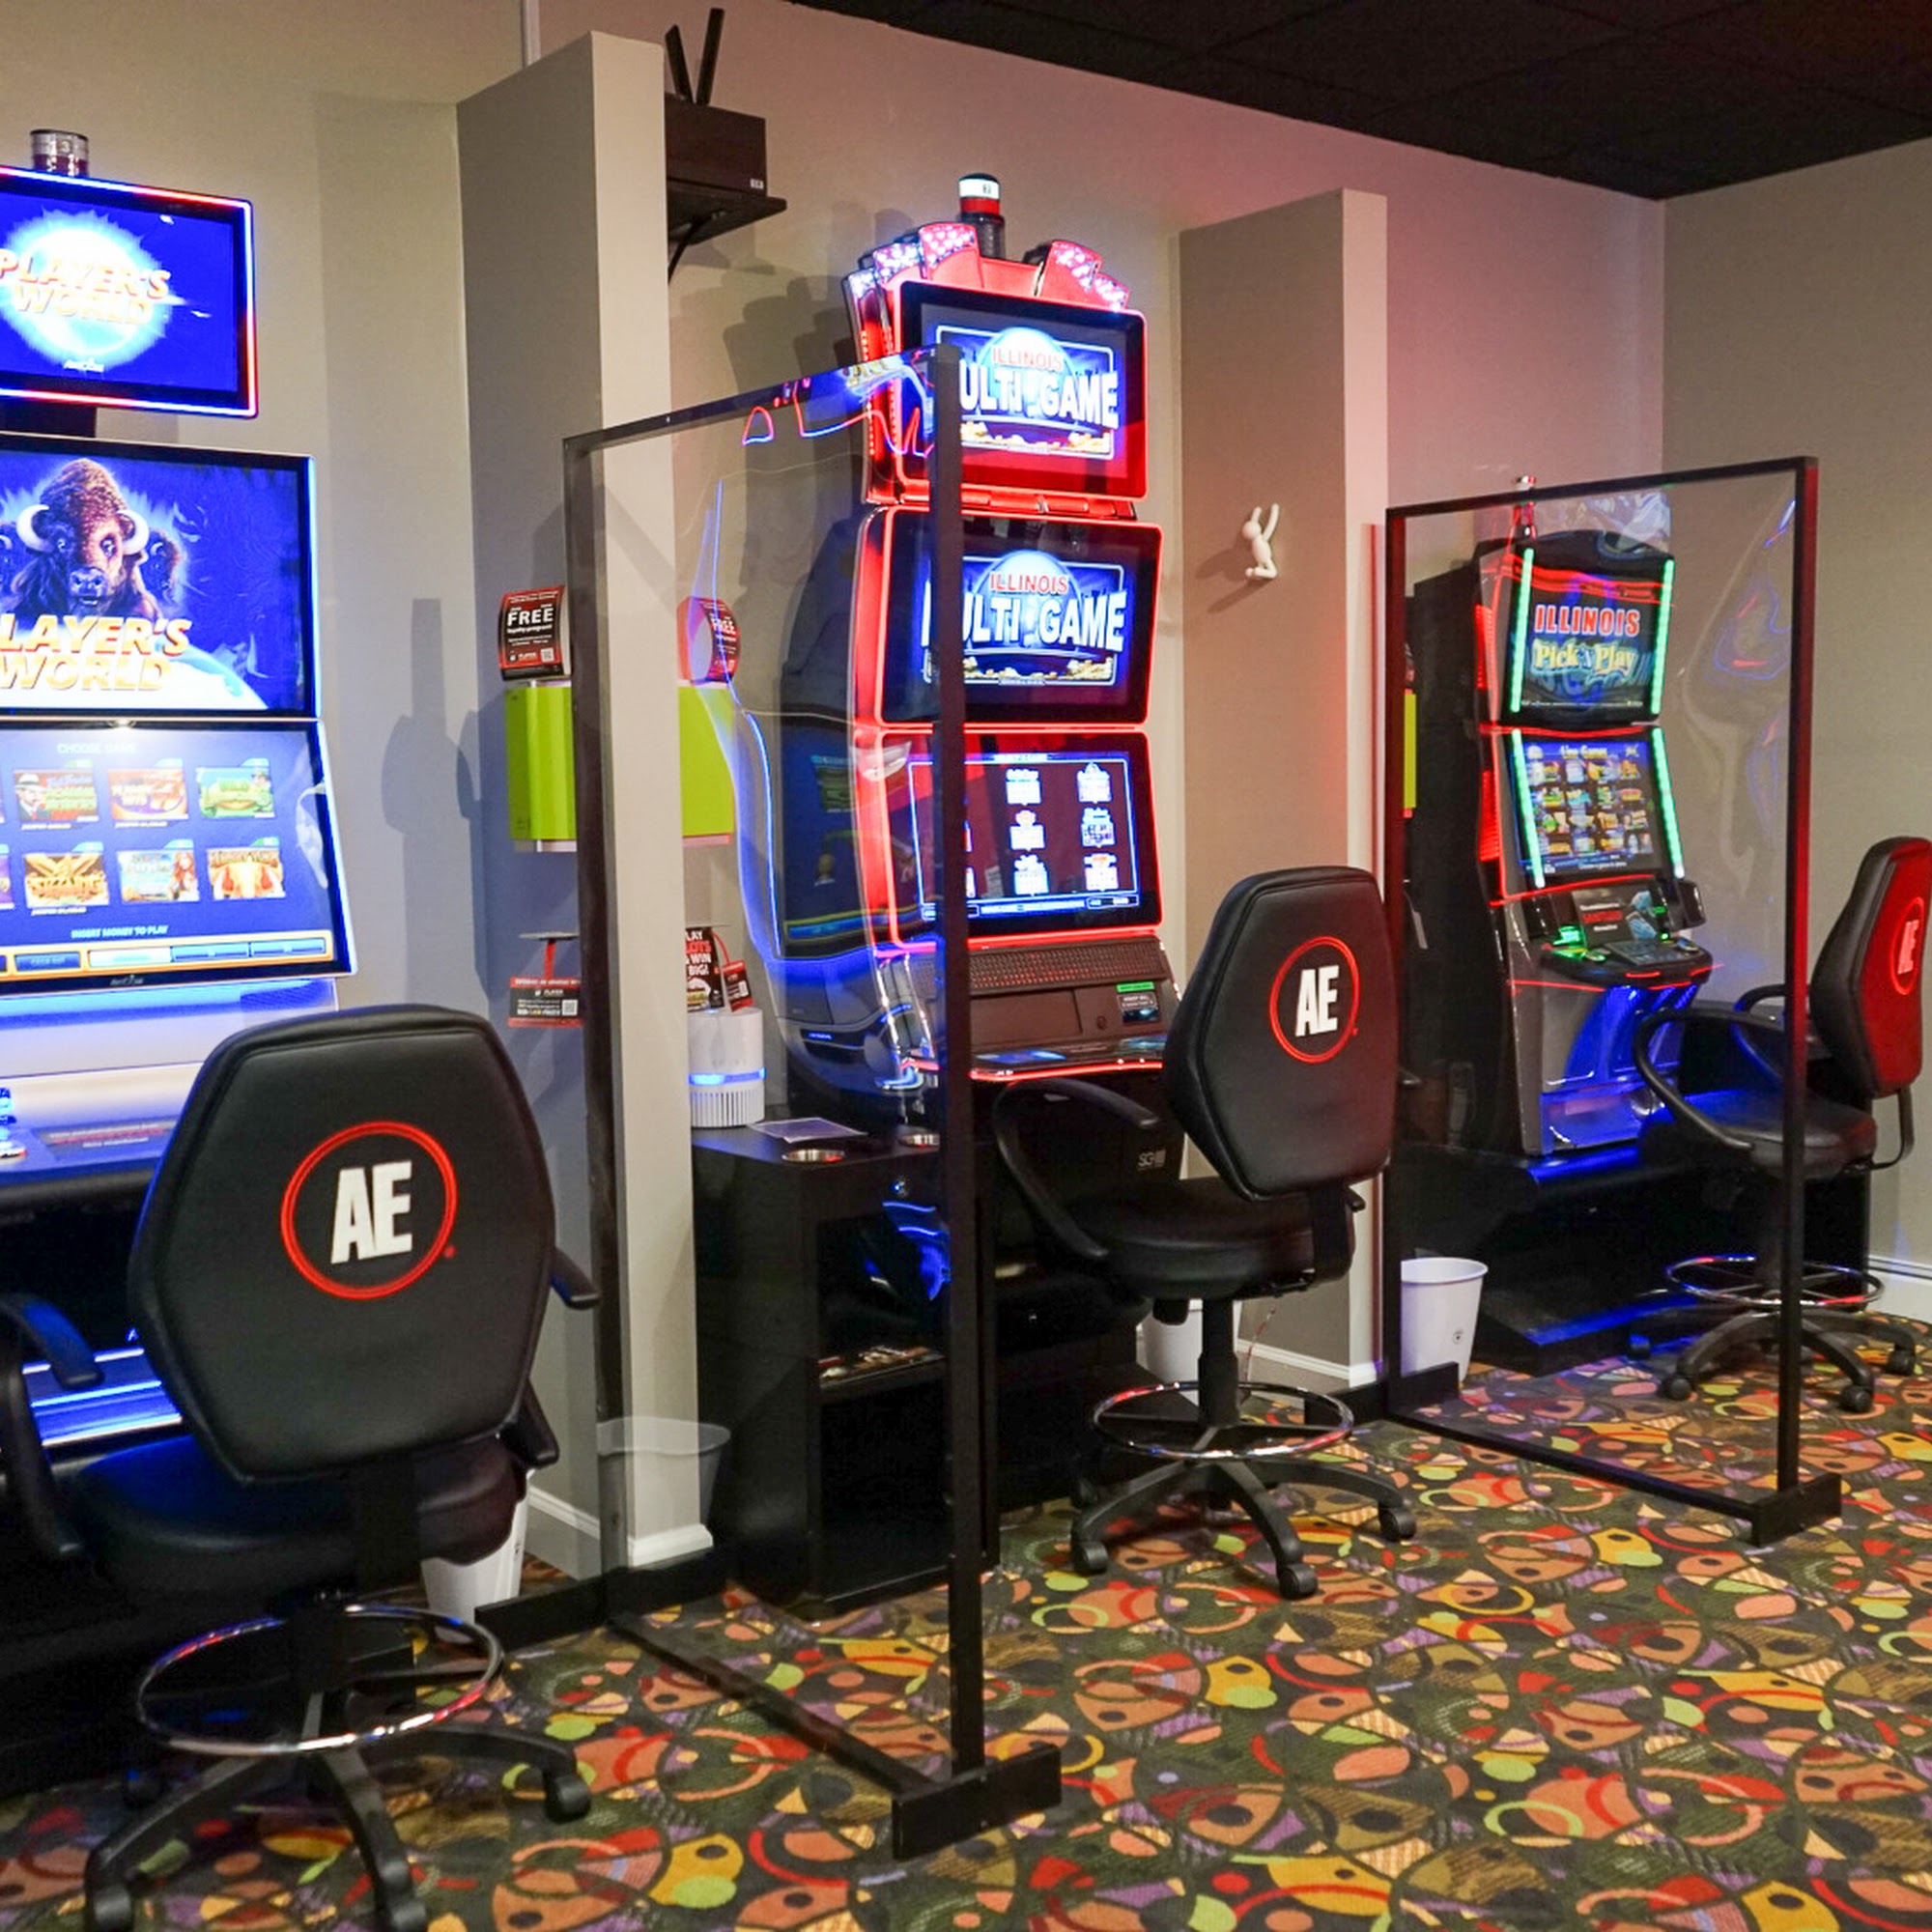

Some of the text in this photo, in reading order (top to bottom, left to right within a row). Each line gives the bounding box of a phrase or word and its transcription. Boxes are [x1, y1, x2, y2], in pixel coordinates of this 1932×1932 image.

[0, 248, 172, 299] PLAYER'S
[14, 284, 153, 325] WORLD
[991, 347, 1065, 372] ILLINOIS
[960, 358, 1119, 429] ULTI GAME
[989, 572, 1069, 594] ILLINOIS
[507, 608, 554, 627] FREE
[1038, 590, 1127, 652] GAME
[1534, 604, 1640, 636] ILLINOIS
[0, 614, 192, 657] LAYER'S
[1534, 640, 1579, 668] Pick
[0, 655, 170, 691] WORLD
[687, 930, 703, 941] LAY
[687, 941, 712, 953] LOTS
[690, 952, 712, 964] WIN
[1294, 964, 1340, 1037] AE
[330, 1160, 412, 1264] AE
